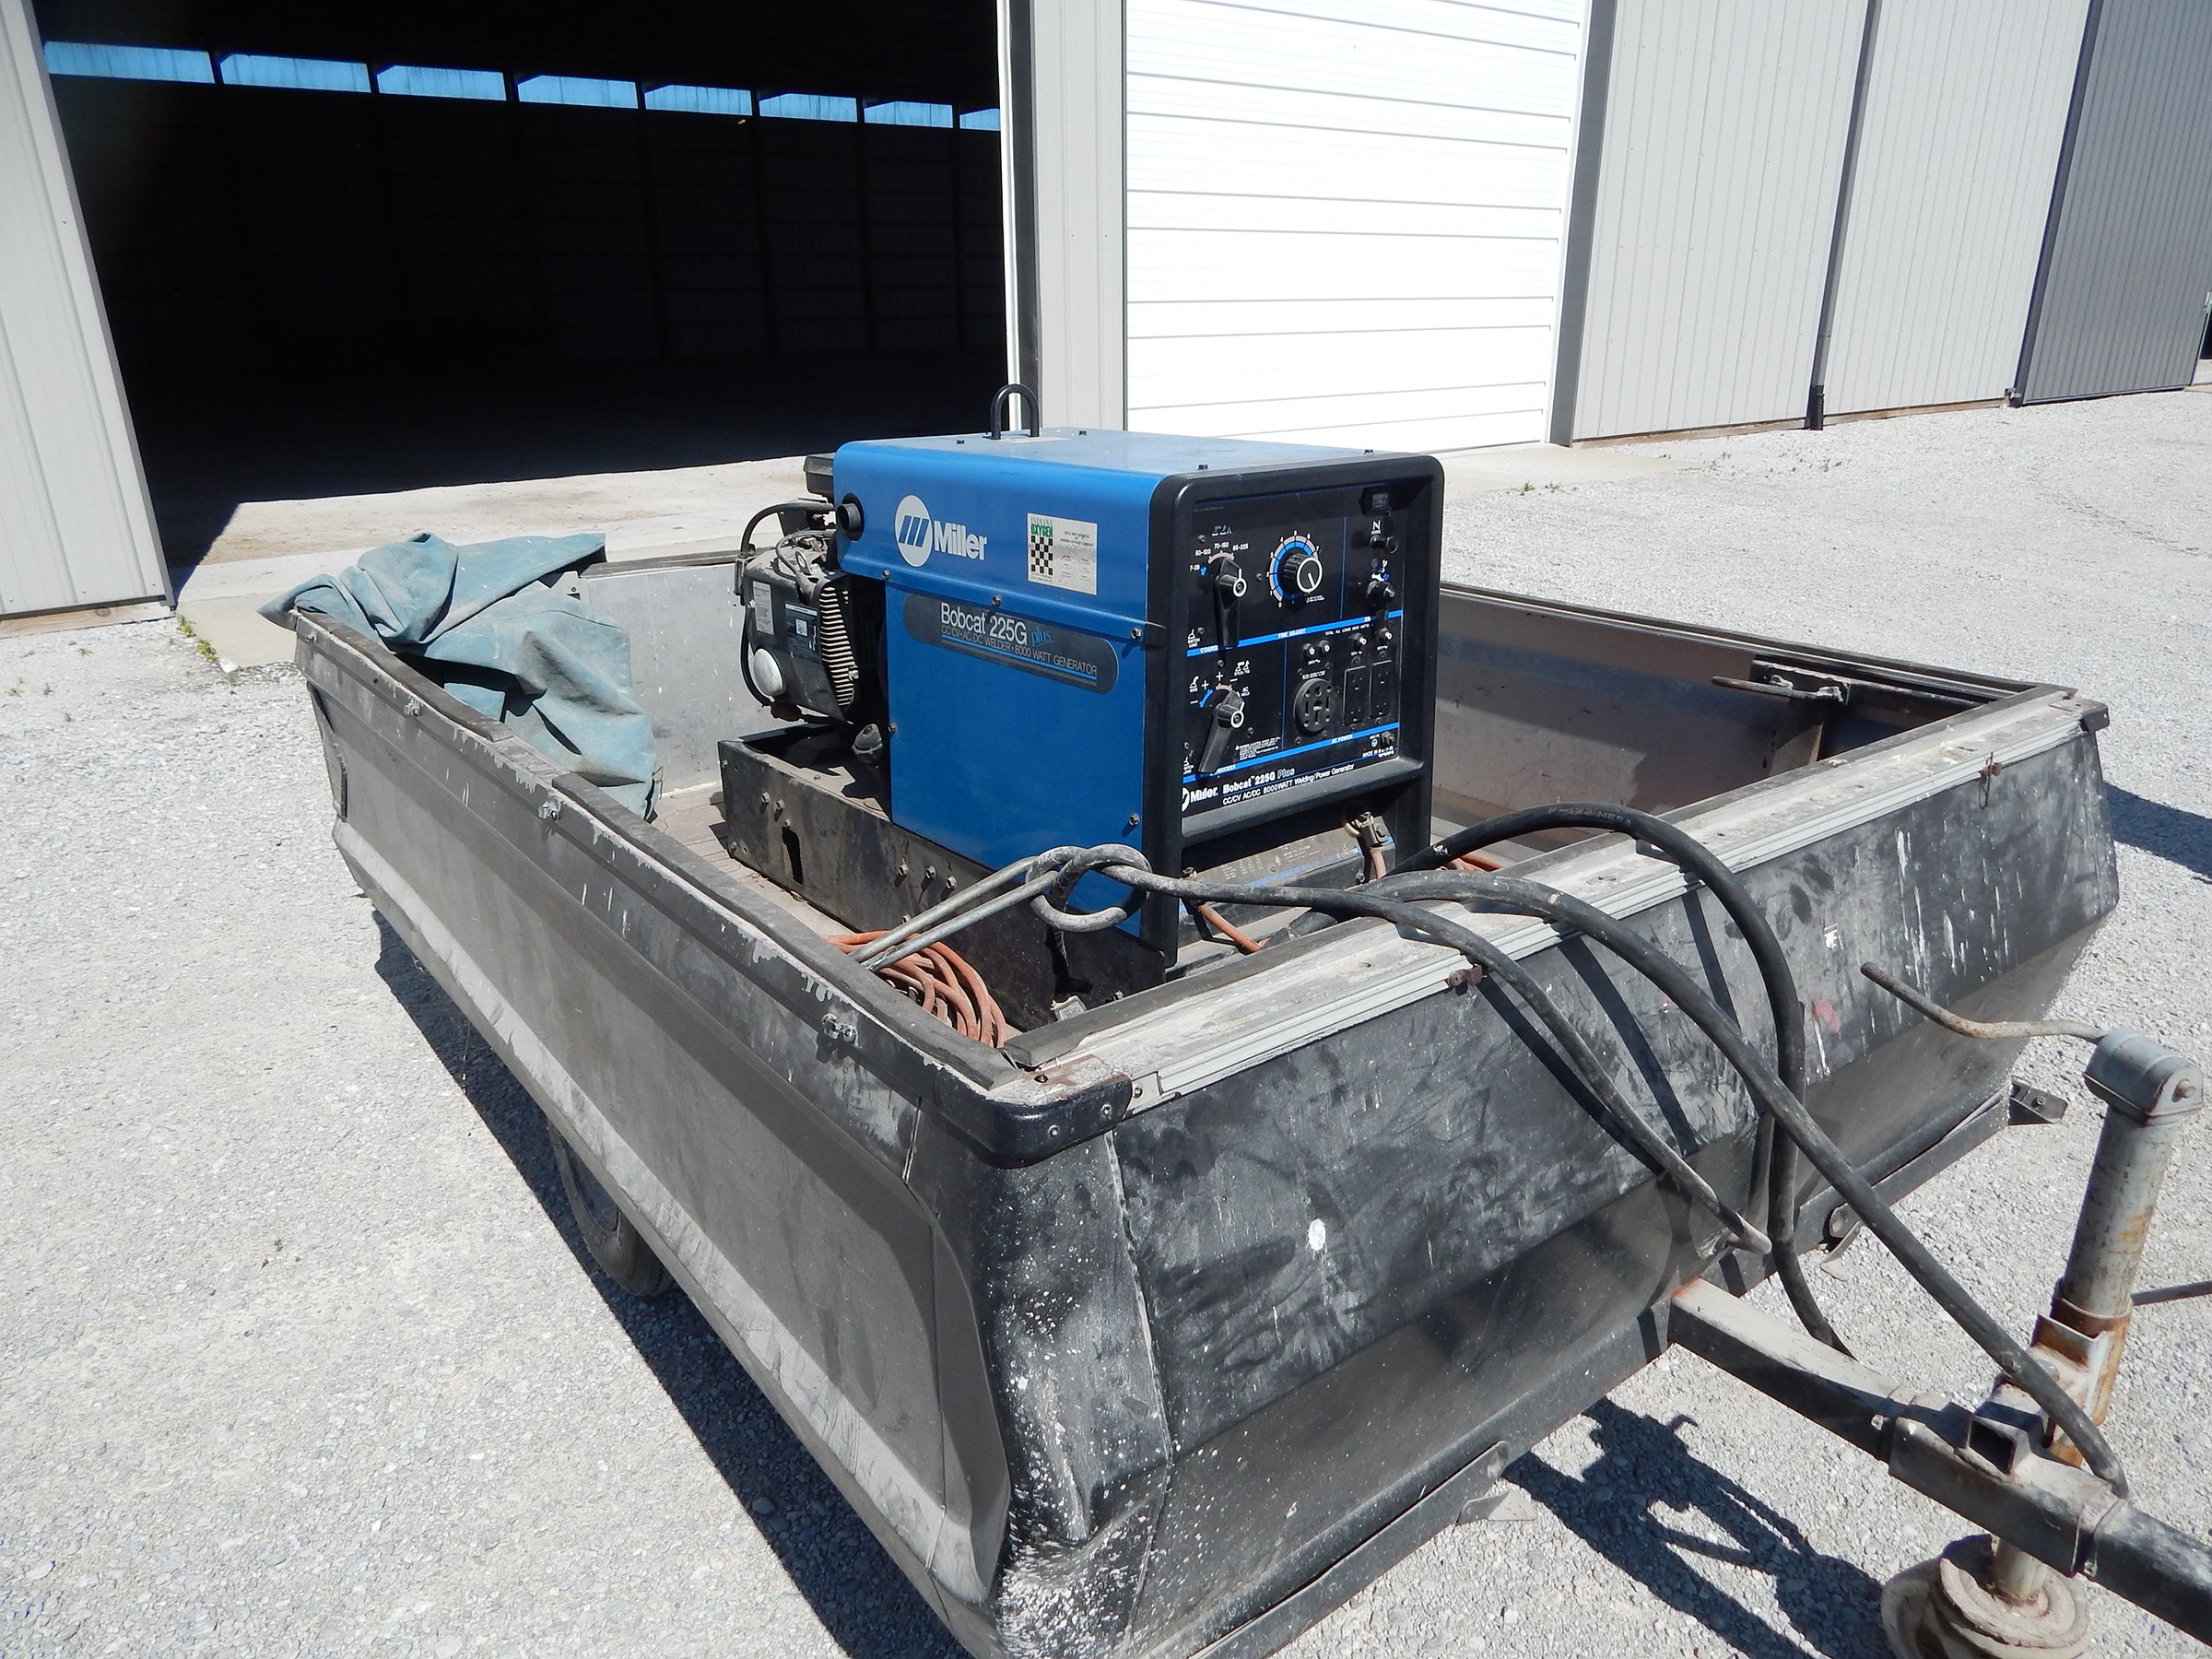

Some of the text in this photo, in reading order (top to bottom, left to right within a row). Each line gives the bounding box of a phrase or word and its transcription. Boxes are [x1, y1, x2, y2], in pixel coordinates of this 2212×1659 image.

[934, 520, 987, 560] Miller
[1030, 524, 1053, 537] OXYGEN
[941, 602, 1052, 647] Bobcat 225G plus
[1288, 628, 1307, 637] ADJUST
[1199, 644, 1219, 654] COARS
[1015, 645, 1031, 658] 8000
[1032, 649, 1052, 663] WATT
[1053, 654, 1098, 676] GENERATOR
[1337, 734, 1354, 743] POWER
[1216, 764, 1236, 775] ROCESS
[1190, 768, 1296, 804] Miller Bobcat 225G Plus
[1222, 794, 1241, 806] CC/CV
[1241, 788, 1262, 800] AC/DC
[1331, 763, 1355, 775] Generator
